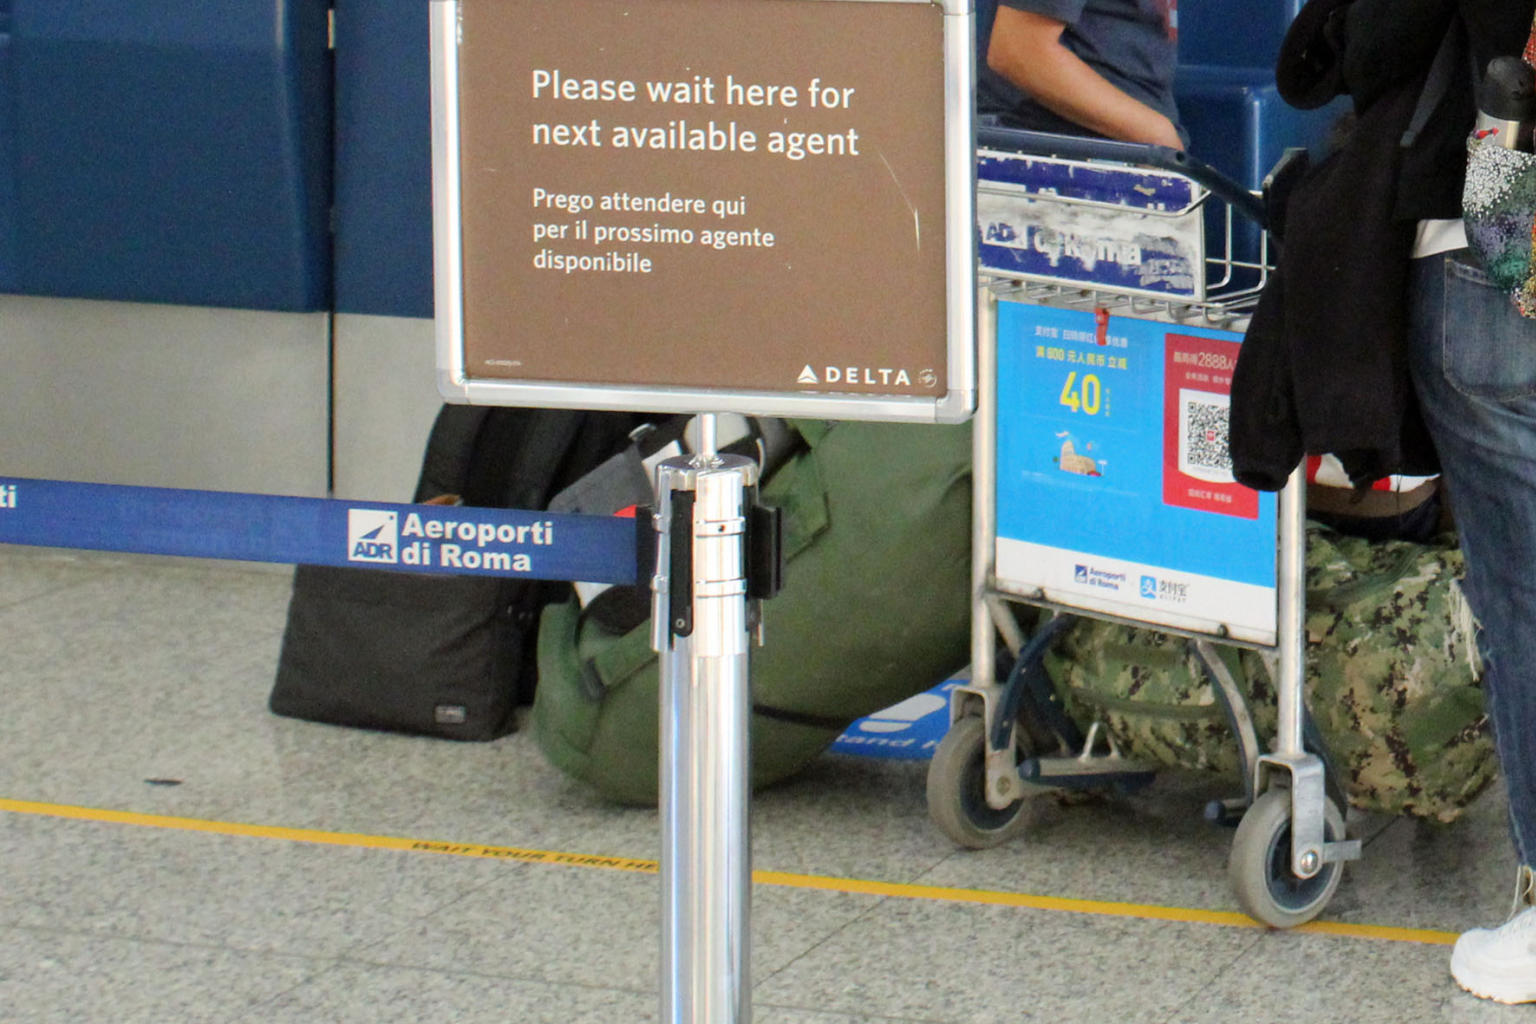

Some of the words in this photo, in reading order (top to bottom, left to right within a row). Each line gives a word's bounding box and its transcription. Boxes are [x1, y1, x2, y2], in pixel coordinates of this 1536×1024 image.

[532, 70, 636, 102] Please
[647, 76, 715, 105] wait
[727, 77, 798, 107] here
[808, 78, 855, 109] for
[532, 118, 601, 147] next
[612, 121, 757, 153] available
[768, 127, 860, 160] agent
[533, 189, 594, 212] Prego
[600, 192, 705, 215] attendere
[712, 196, 746, 219] qui
[533, 223, 568, 244] per
[575, 220, 587, 241] il
[594, 222, 695, 247] prossimo
[700, 228, 776, 250] agente
[533, 251, 653, 275] disponibile
[825, 366, 911, 387] DELTA
[1060, 371, 1101, 415] 40
[402, 513, 553, 547] Aeroporti
[353, 542, 392, 560] ADR
[402, 542, 431, 565] di
[441, 544, 531, 572] Roma
[481, 848, 546, 860] YOUR
[554, 855, 620, 867] TURN
